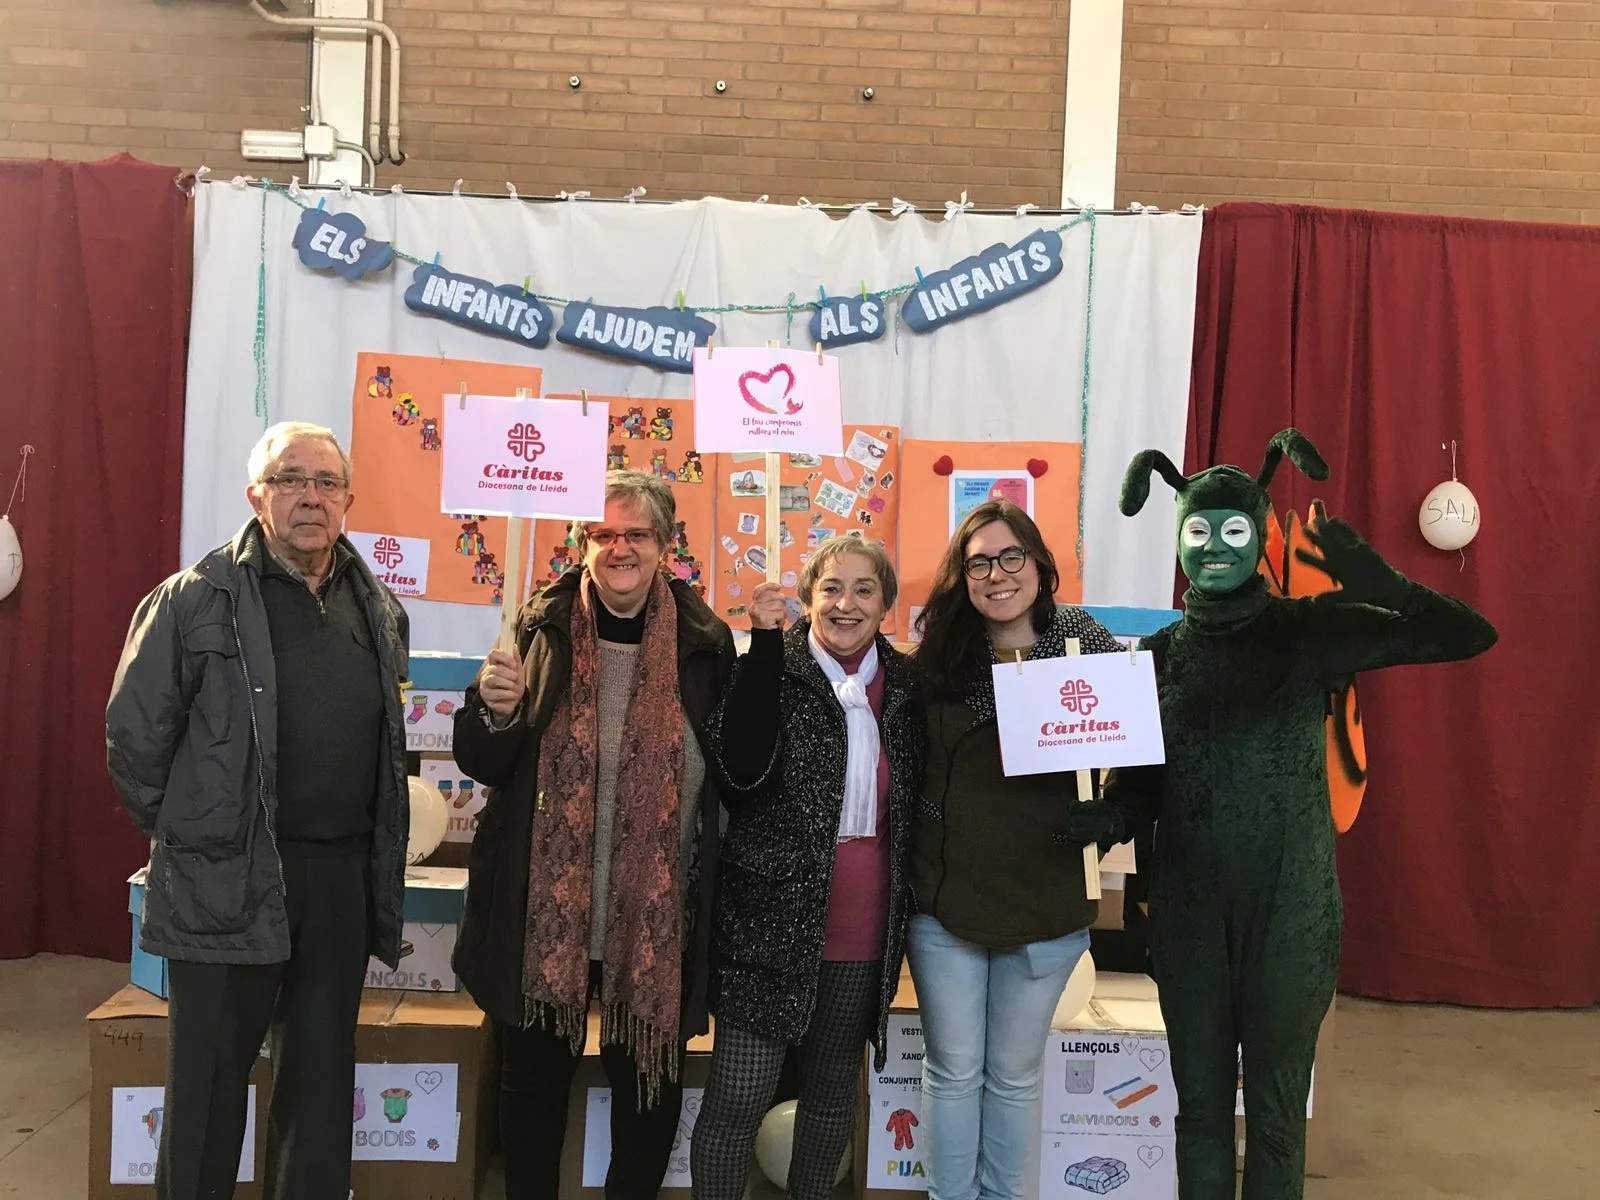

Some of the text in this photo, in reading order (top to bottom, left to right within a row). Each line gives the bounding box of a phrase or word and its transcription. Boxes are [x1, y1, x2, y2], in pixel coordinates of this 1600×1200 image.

[310, 223, 1052, 362] ELS INFANTS AJUDEM ALS INFANTS
[743, 417, 750, 426] El
[752, 417, 764, 426] teu
[748, 427, 772, 436] millora
[772, 427, 779, 436] el
[483, 463, 564, 482] Càritas
[477, 480, 568, 493] Diocesana de Lleida
[1040, 718, 1120, 736] Càritas
[1037, 733, 1127, 748] Diocesana de Lleida
[1061, 1041, 1120, 1056] LLENÇOLS
[1060, 1113, 1140, 1127] CANVIADORS
[355, 1129, 416, 1147] BODIS
[887, 1160, 926, 1178] PIJA
